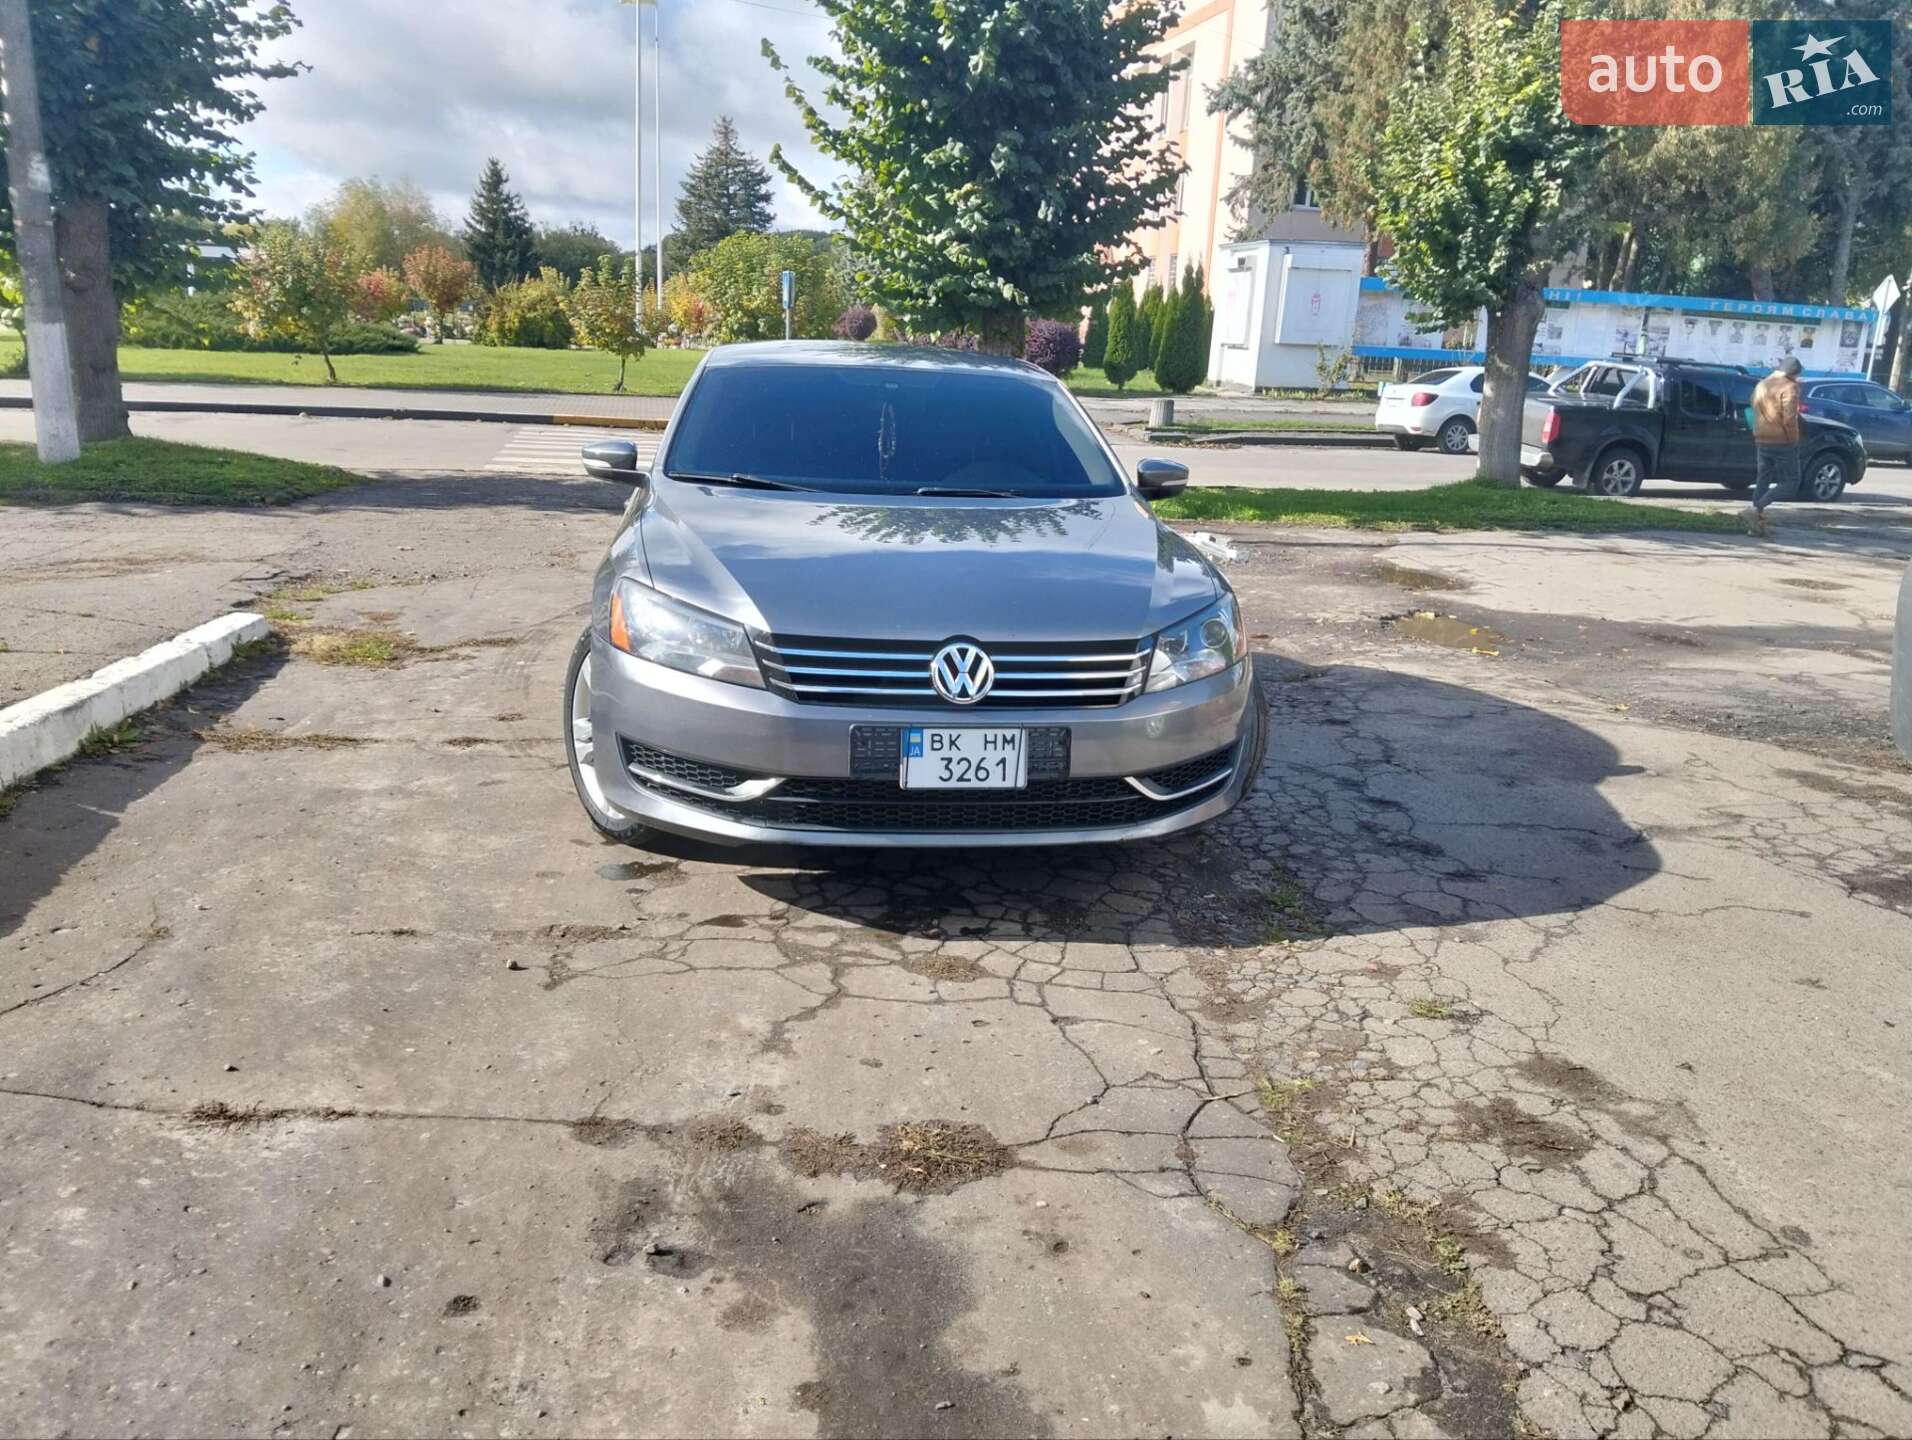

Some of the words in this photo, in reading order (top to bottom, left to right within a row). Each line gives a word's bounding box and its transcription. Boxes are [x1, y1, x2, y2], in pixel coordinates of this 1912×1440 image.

[1709, 302, 1793, 316] ГЕРОЯМ
[930, 733, 962, 751] BK
[984, 733, 1016, 751] HM
[938, 756, 1007, 782] 3261
